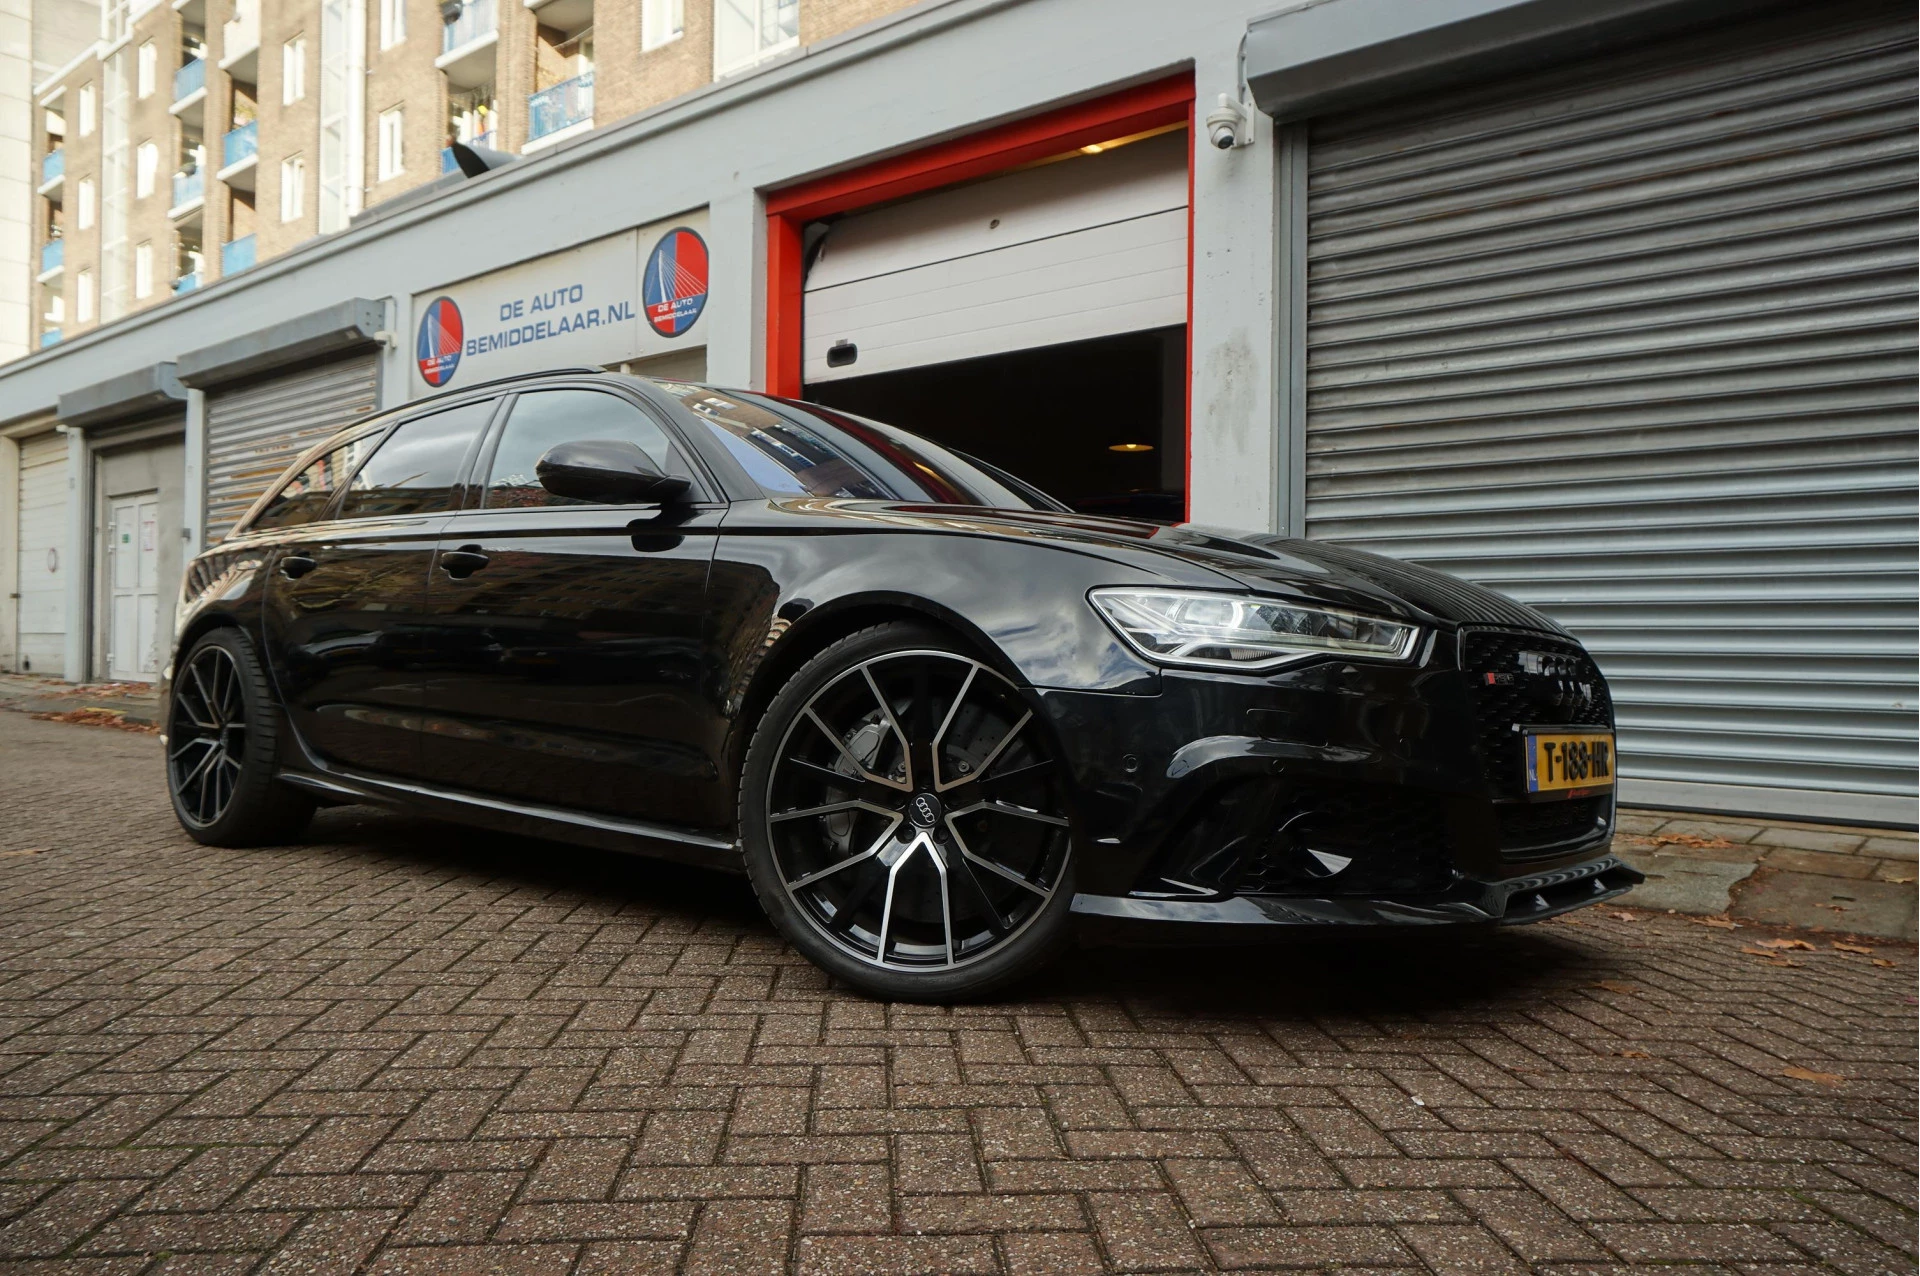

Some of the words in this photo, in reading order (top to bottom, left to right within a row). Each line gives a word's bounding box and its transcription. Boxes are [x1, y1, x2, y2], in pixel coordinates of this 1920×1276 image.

[500, 299, 524, 322] DE
[530, 284, 583, 314] AUTO
[657, 303, 669, 313] DE
[670, 298, 693, 310] AUTO
[466, 301, 635, 357] BEMIDDELAAR.NL
[1529, 769, 1537, 781] NL
[1543, 741, 1609, 783] T-188-HR
